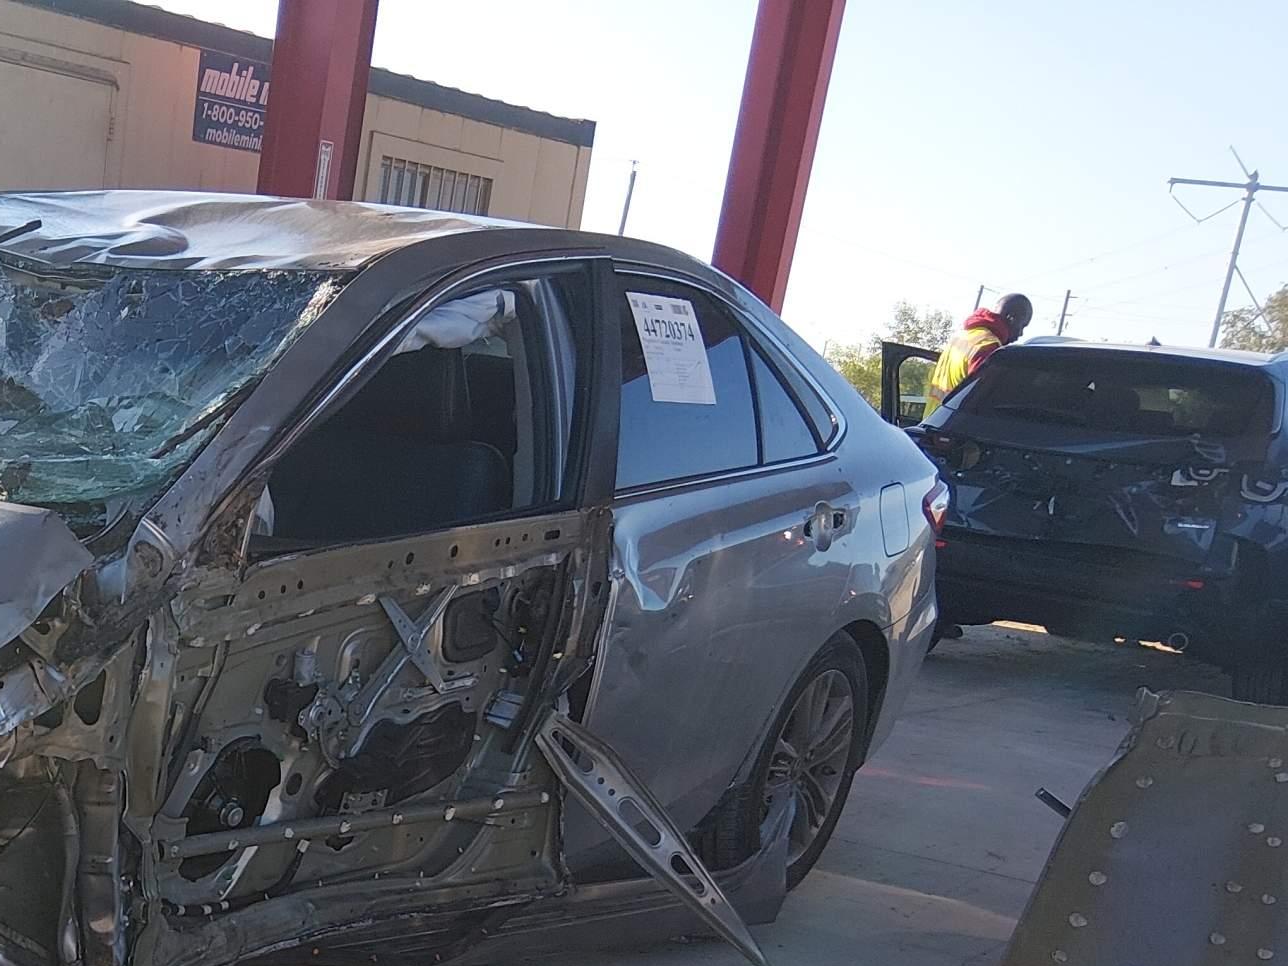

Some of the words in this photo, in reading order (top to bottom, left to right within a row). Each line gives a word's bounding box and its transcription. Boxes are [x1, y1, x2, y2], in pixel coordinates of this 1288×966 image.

[200, 62, 260, 103] mobile
[202, 102, 264, 129] 1-800-950-
[205, 128, 263, 150] mobilemini
[643, 318, 695, 342] 44720374
